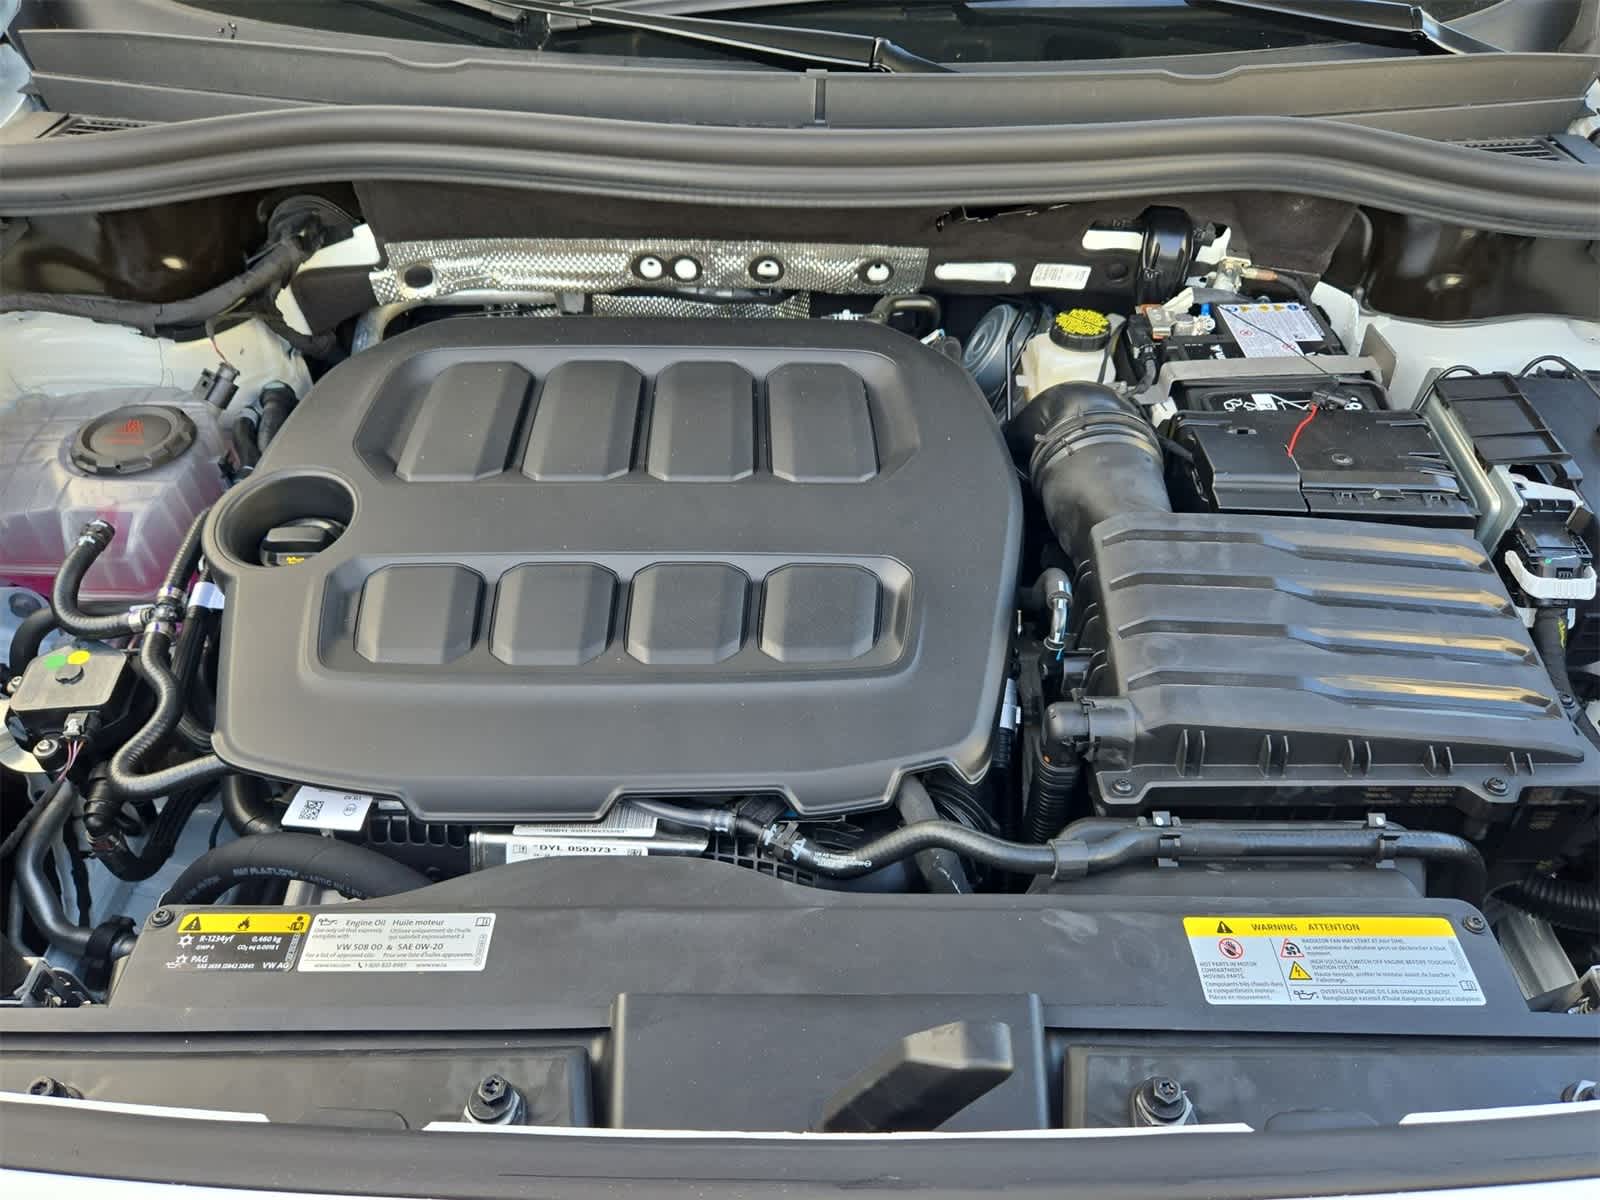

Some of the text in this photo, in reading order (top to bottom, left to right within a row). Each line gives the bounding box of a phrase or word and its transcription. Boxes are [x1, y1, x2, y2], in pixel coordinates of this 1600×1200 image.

[345, 919, 372, 927] Engine
[1251, 923, 1360, 932] WARNING ATTENTION
[200, 934, 236, 945] R-1234yf
[272, 935, 282, 944] kg
[336, 943, 444, 951] VW 508 00 & SAE 0W-20
[262, 961, 290, 970] VW AG
